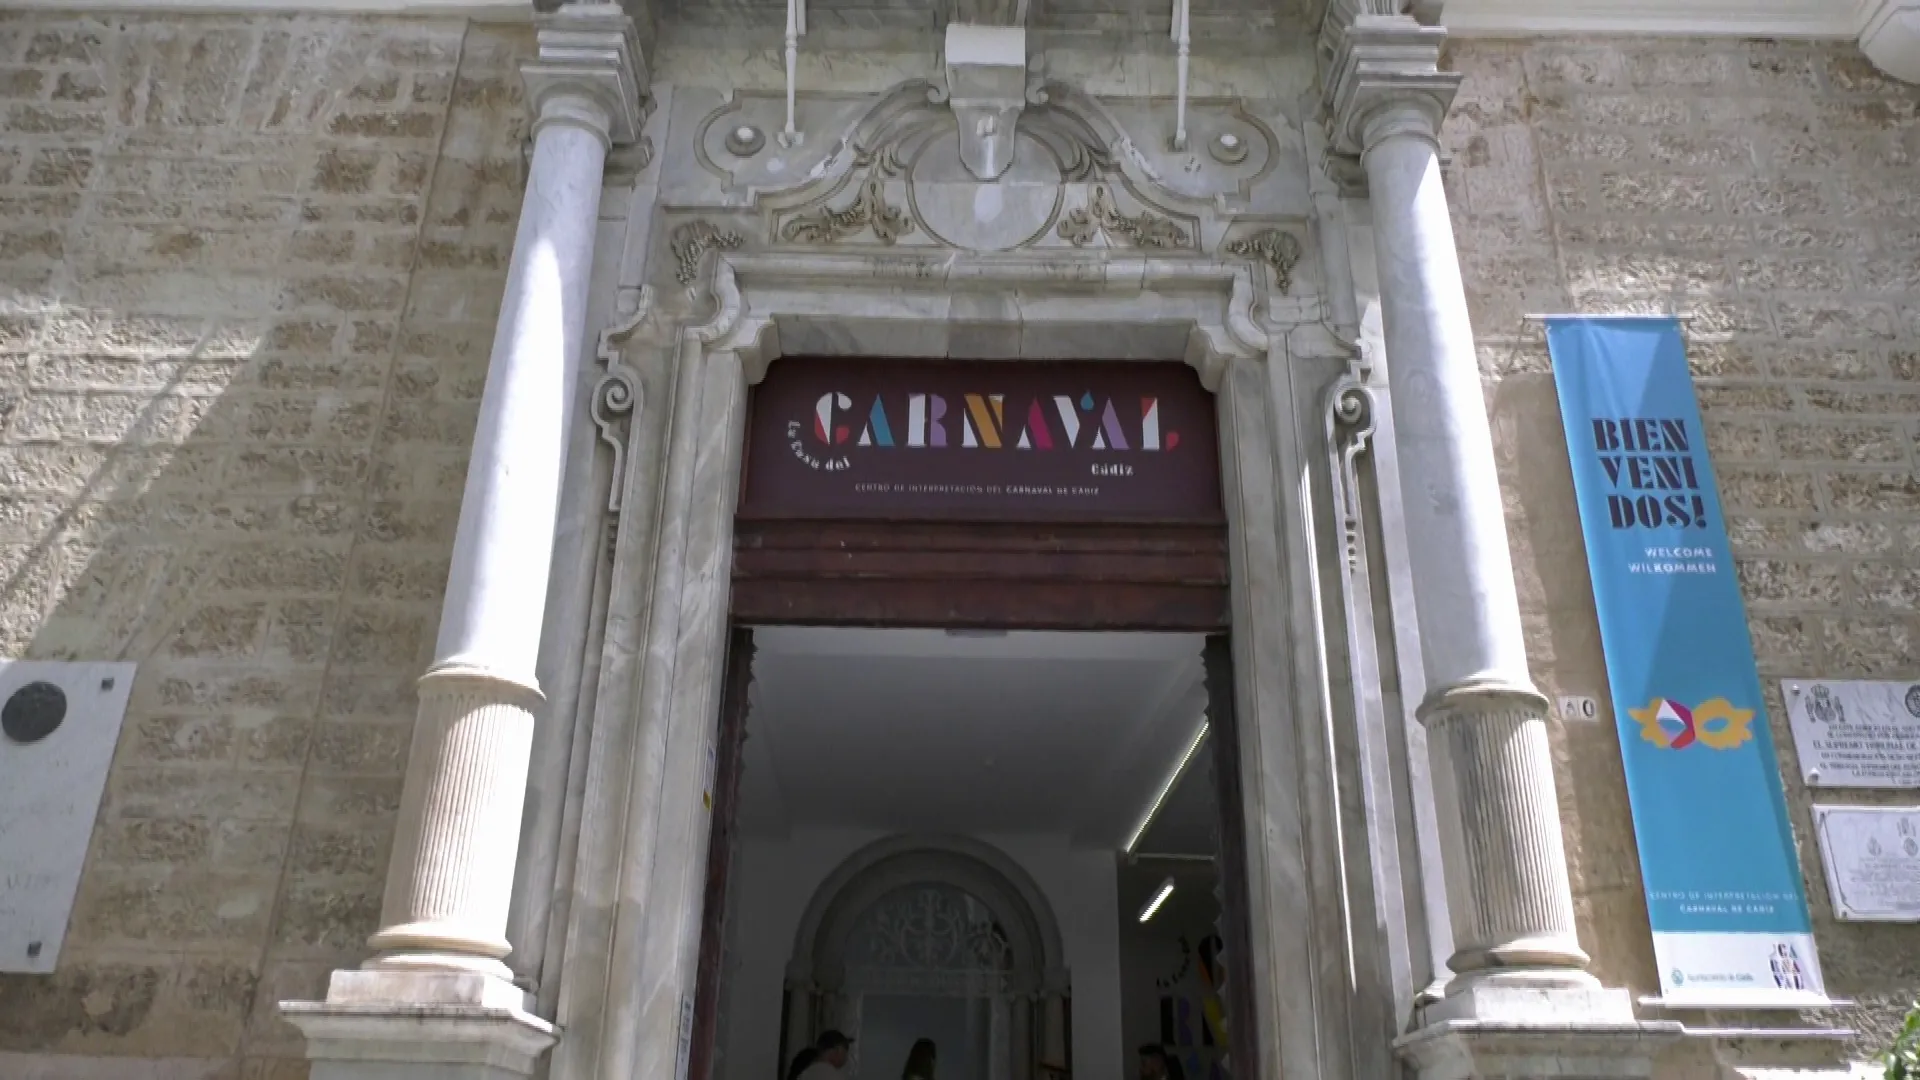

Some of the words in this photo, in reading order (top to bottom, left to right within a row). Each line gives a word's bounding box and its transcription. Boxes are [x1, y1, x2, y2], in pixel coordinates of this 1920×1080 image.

[814, 391, 1179, 451] CARNAVAL
[1592, 418, 1690, 452] BIEN
[1599, 456, 1699, 490] VENI
[1607, 495, 1707, 530] DOS!
[1628, 562, 1717, 574] WILKOMMEN
[1644, 547, 1713, 558] WELCOME
